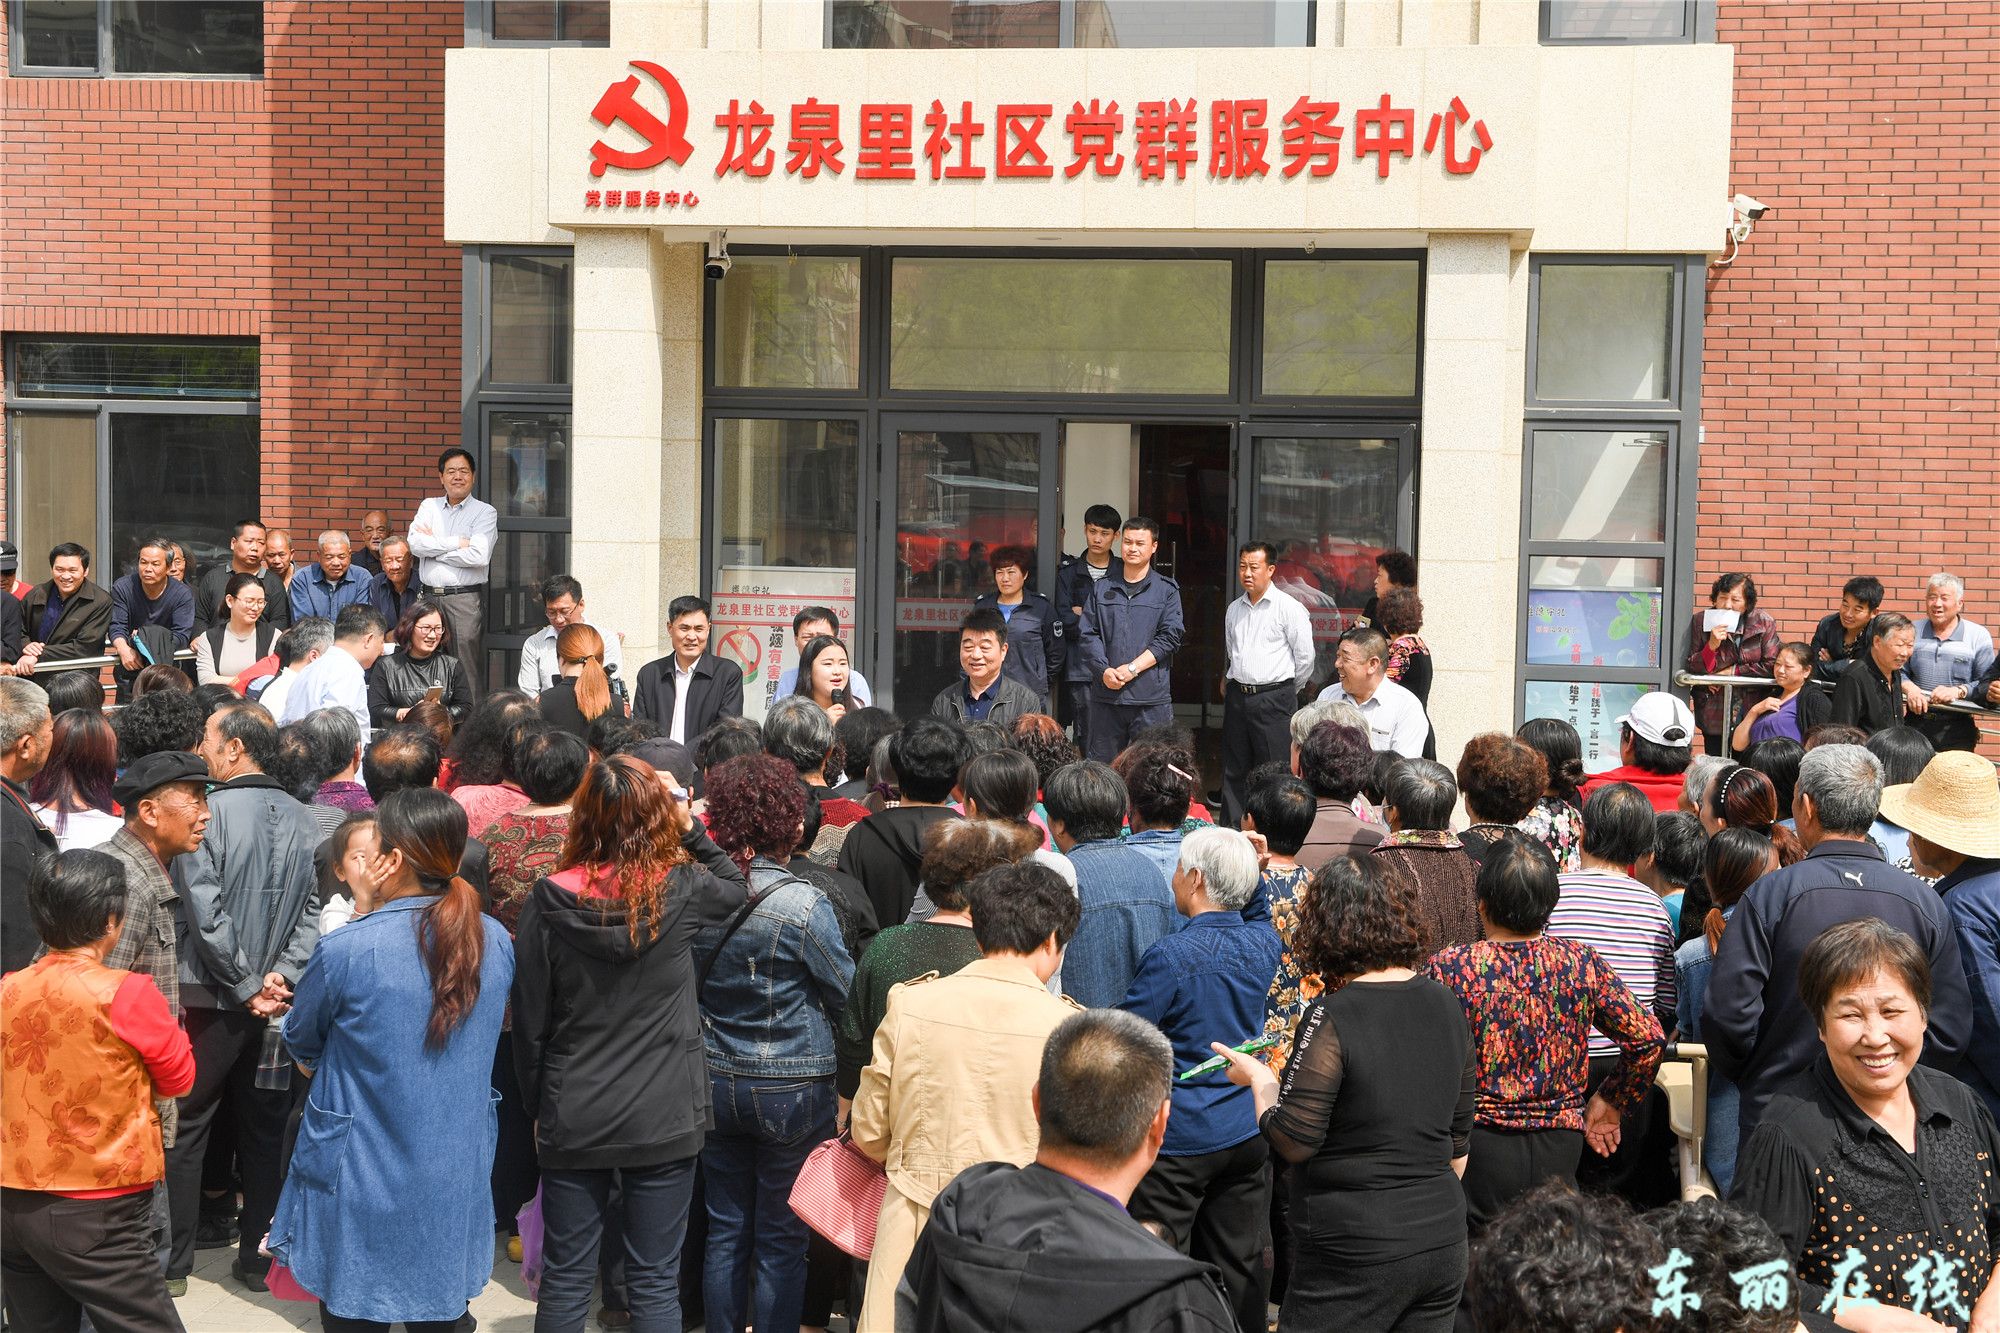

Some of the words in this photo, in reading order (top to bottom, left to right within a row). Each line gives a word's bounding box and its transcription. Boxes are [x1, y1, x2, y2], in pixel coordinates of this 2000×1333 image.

[714, 93, 1492, 180] 龙泉里社区党群服务中心
[585, 189, 700, 208] 党群服务中心
